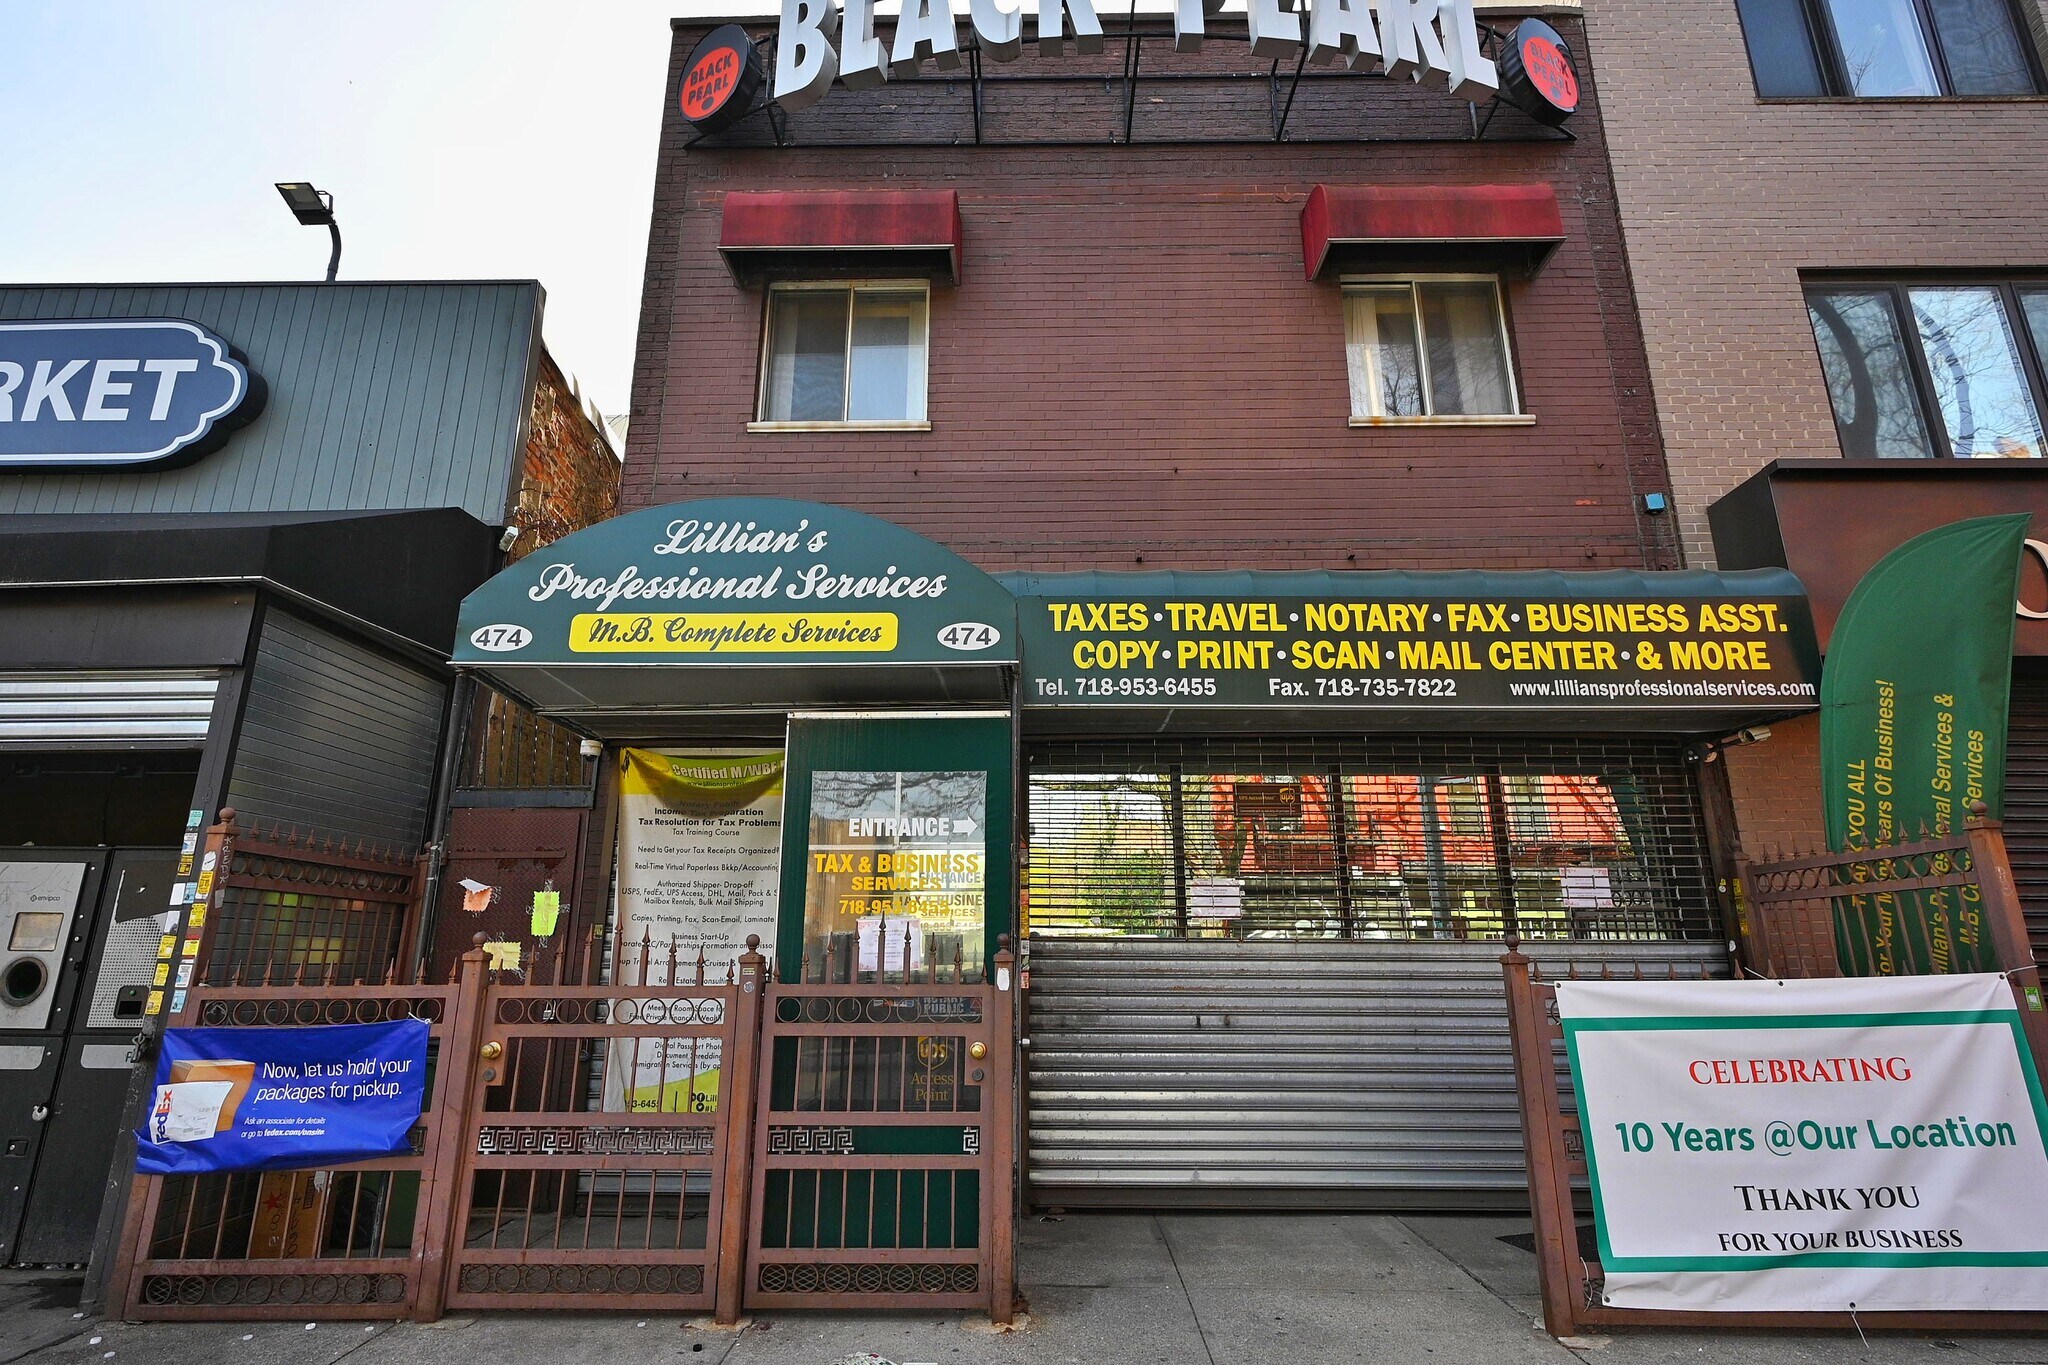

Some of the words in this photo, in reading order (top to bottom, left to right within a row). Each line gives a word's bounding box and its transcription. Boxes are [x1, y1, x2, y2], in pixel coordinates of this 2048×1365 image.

[690, 51, 733, 87] BLACK
[687, 74, 729, 106] PEARL
[653, 519, 828, 555] Lillian's
[528, 563, 783, 611] Professional
[785, 563, 948, 600] Services
[1048, 603, 1149, 632] TAXES
[1165, 603, 1287, 632] TRAVEL
[1304, 603, 1429, 632] NOTARY
[1447, 604, 1511, 632] FAX
[1525, 604, 1690, 632] BUSINESS
[1698, 604, 1788, 632] ASST.
[475, 629, 523, 647] 474
[589, 616, 655, 643] M.B.
[664, 616, 777, 651] Complete
[782, 618, 883, 643] Services
[943, 627, 992, 645] 474
[1072, 640, 1160, 670] COPY
[1177, 641, 1274, 670] PRINT
[1291, 641, 1380, 670] SCAN
[1399, 641, 1482, 670] MAIL
[1488, 641, 1618, 670] CENTER
[1635, 641, 1664, 670] &
[1669, 641, 1771, 670] MORE
[1035, 678, 1069, 696] Tel.
[1075, 678, 1217, 697] 718-953-6455
[1268, 678, 1310, 697] Fax.
[1315, 678, 1457, 697] 718-735-7822
[1510, 678, 1816, 699] www.lilliansprofessionalservices.com
[1933, 693, 1953, 707] &
[1875, 679, 1895, 771] Business!
[1931, 711, 1952, 792] Services
[672, 763, 728, 779] Certified
[1848, 759, 1866, 795] ALL
[1874, 773, 1894, 795] Of
[654, 807, 688, 816] Income
[639, 818, 654, 826] Tax
[655, 818, 700, 827] Resolution
[702, 818, 716, 827] for
[718, 819, 736, 827] Tax
[849, 817, 950, 837] ENTRANCE
[673, 828, 684, 836] Tax
[686, 828, 713, 838] Training
[715, 828, 740, 836] Course
[637, 845, 656, 853] Need
[664, 846, 675, 854] Get
[676, 848, 691, 856] your
[707, 846, 737, 856] Receipts
[666, 863, 685, 871] Virtual
[687, 864, 719, 873] Paperless
[814, 854, 855, 873] TAX
[858, 855, 871, 873] &
[877, 854, 980, 873] BUSINESS
[621, 888, 642, 896] USPS,
[643, 888, 664, 897] FedEx,
[666, 889, 680, 897] UPS
[681, 890, 706, 898] Access,
[708, 890, 724, 898] DHL,
[728, 889, 746, 898] Mail,
[748, 889, 764, 897] Pack
[765, 889, 772, 897] &
[657, 880, 691, 888] Authorized
[723, 880, 754, 890] Drop-off
[851, 876, 942, 891] SERVICES
[643, 897, 670, 905] Mailbox
[671, 898, 697, 907] Rentals,
[699, 898, 713, 906] Bulk
[715, 898, 732, 906] Mail
[734, 898, 764, 908] Shipping
[839, 900, 950, 914] 718-953-6455
[631, 913, 655, 923] Copies,
[656, 914, 684, 925] Printing,
[685, 915, 700, 925] Fax,
[700, 932, 729, 942] Start-Up
[703, 959, 730, 967] Cruises
[262, 1062, 300, 1080] Now,
[303, 1060, 323, 1078] let
[327, 1063, 343, 1076] us
[347, 1058, 376, 1076] hold
[379, 1058, 413, 1080] your
[672, 1062, 698, 1070] Servics
[1688, 1057, 1912, 1085] CELEBRATING
[253, 1084, 326, 1104] packages
[329, 1082, 348, 1098] for
[352, 1079, 403, 1101] pickup.
[154, 1089, 173, 1143] FedEx
[1615, 1122, 1655, 1153] 10
[1661, 1120, 1755, 1153] Years
[1763, 1119, 1858, 1157] @Our
[1866, 1116, 2017, 1150] Location
[1733, 1185, 1851, 1212] THANK
[1857, 1185, 1920, 1210] YOU
[1717, 1232, 1770, 1252] FOR
[1771, 1231, 1840, 1251] YOUR
[1845, 1229, 1964, 1249] BUSINESS
